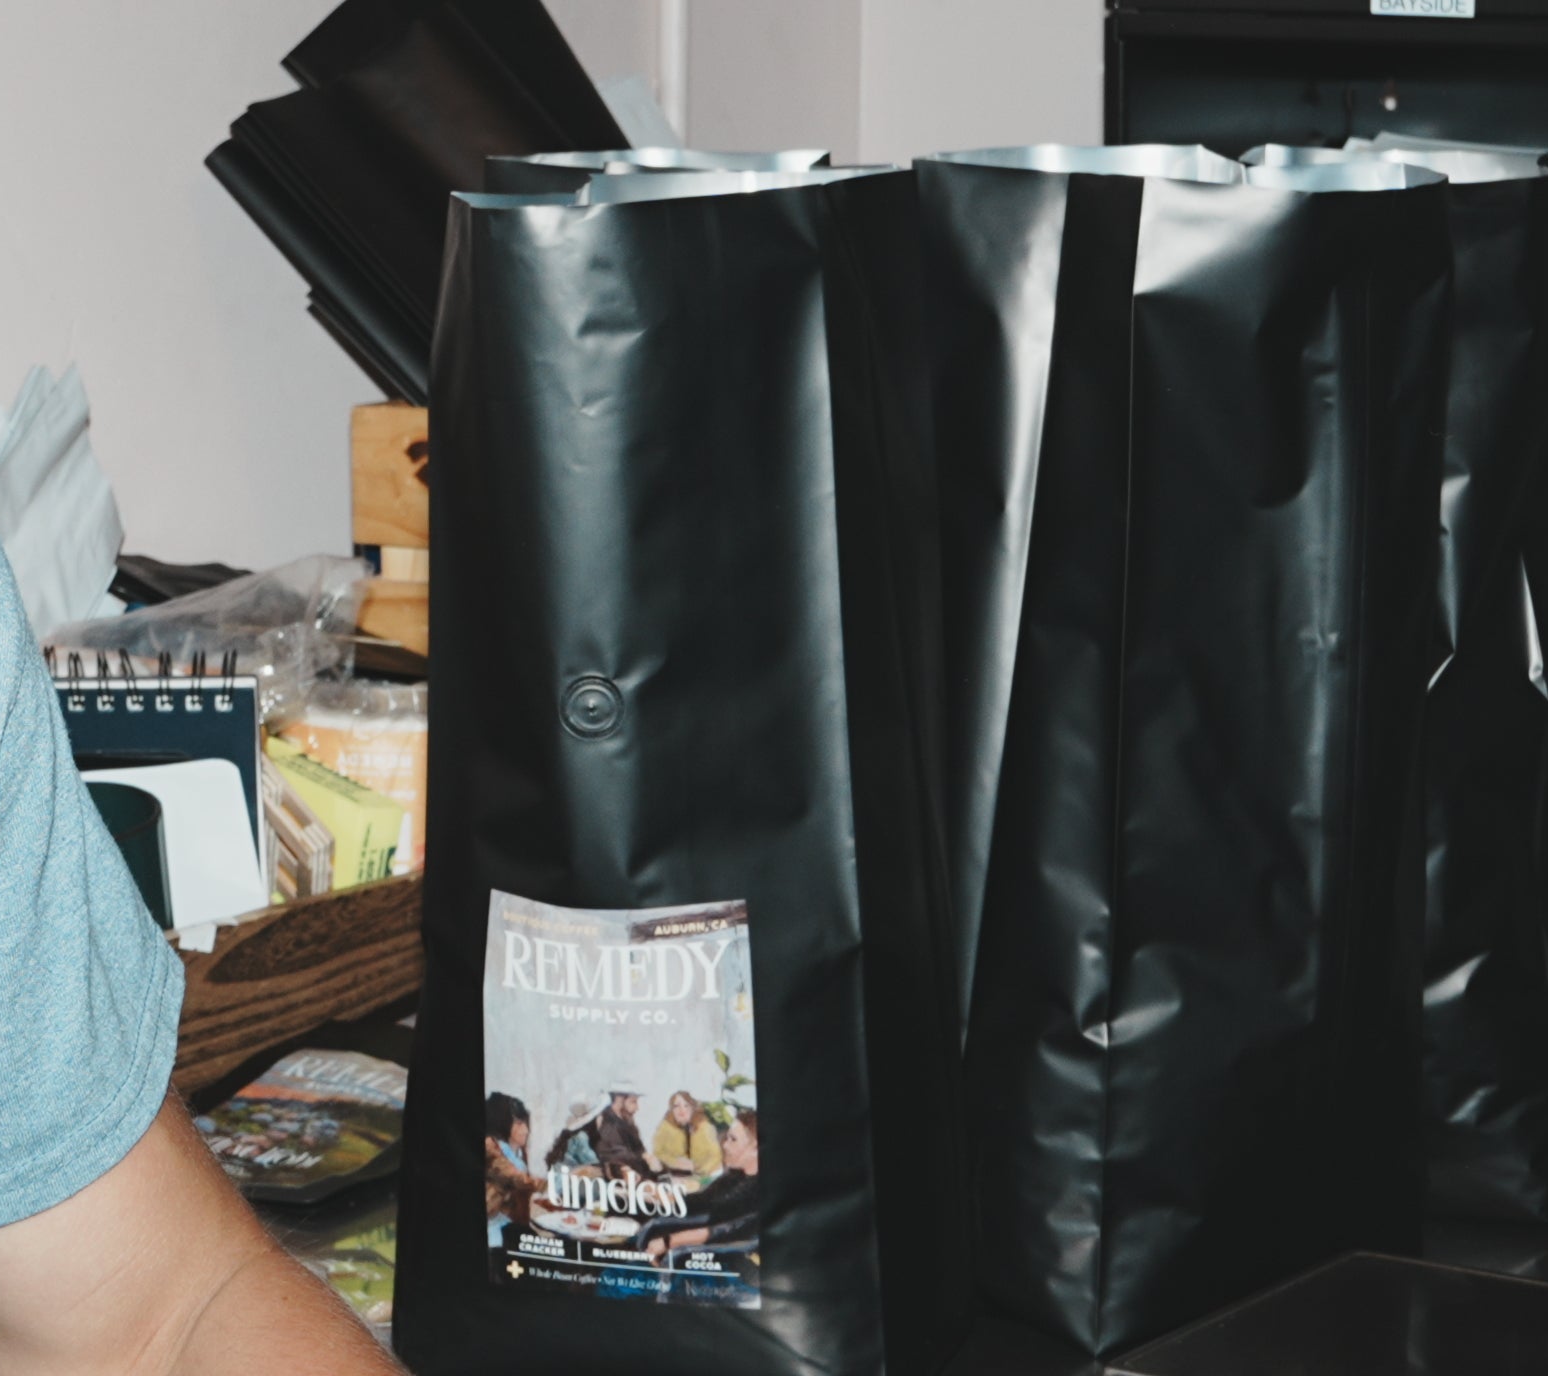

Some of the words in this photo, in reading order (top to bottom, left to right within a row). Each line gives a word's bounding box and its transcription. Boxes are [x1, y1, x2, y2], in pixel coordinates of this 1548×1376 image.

[502, 929, 733, 1002] REMEDY
[549, 1004, 630, 1025] SUPPLY
[639, 1008, 677, 1026] CO.
[546, 1164, 689, 1220] timeless
[592, 1248, 656, 1262] BLUEBERRY
[685, 1260, 722, 1272] COCOA
